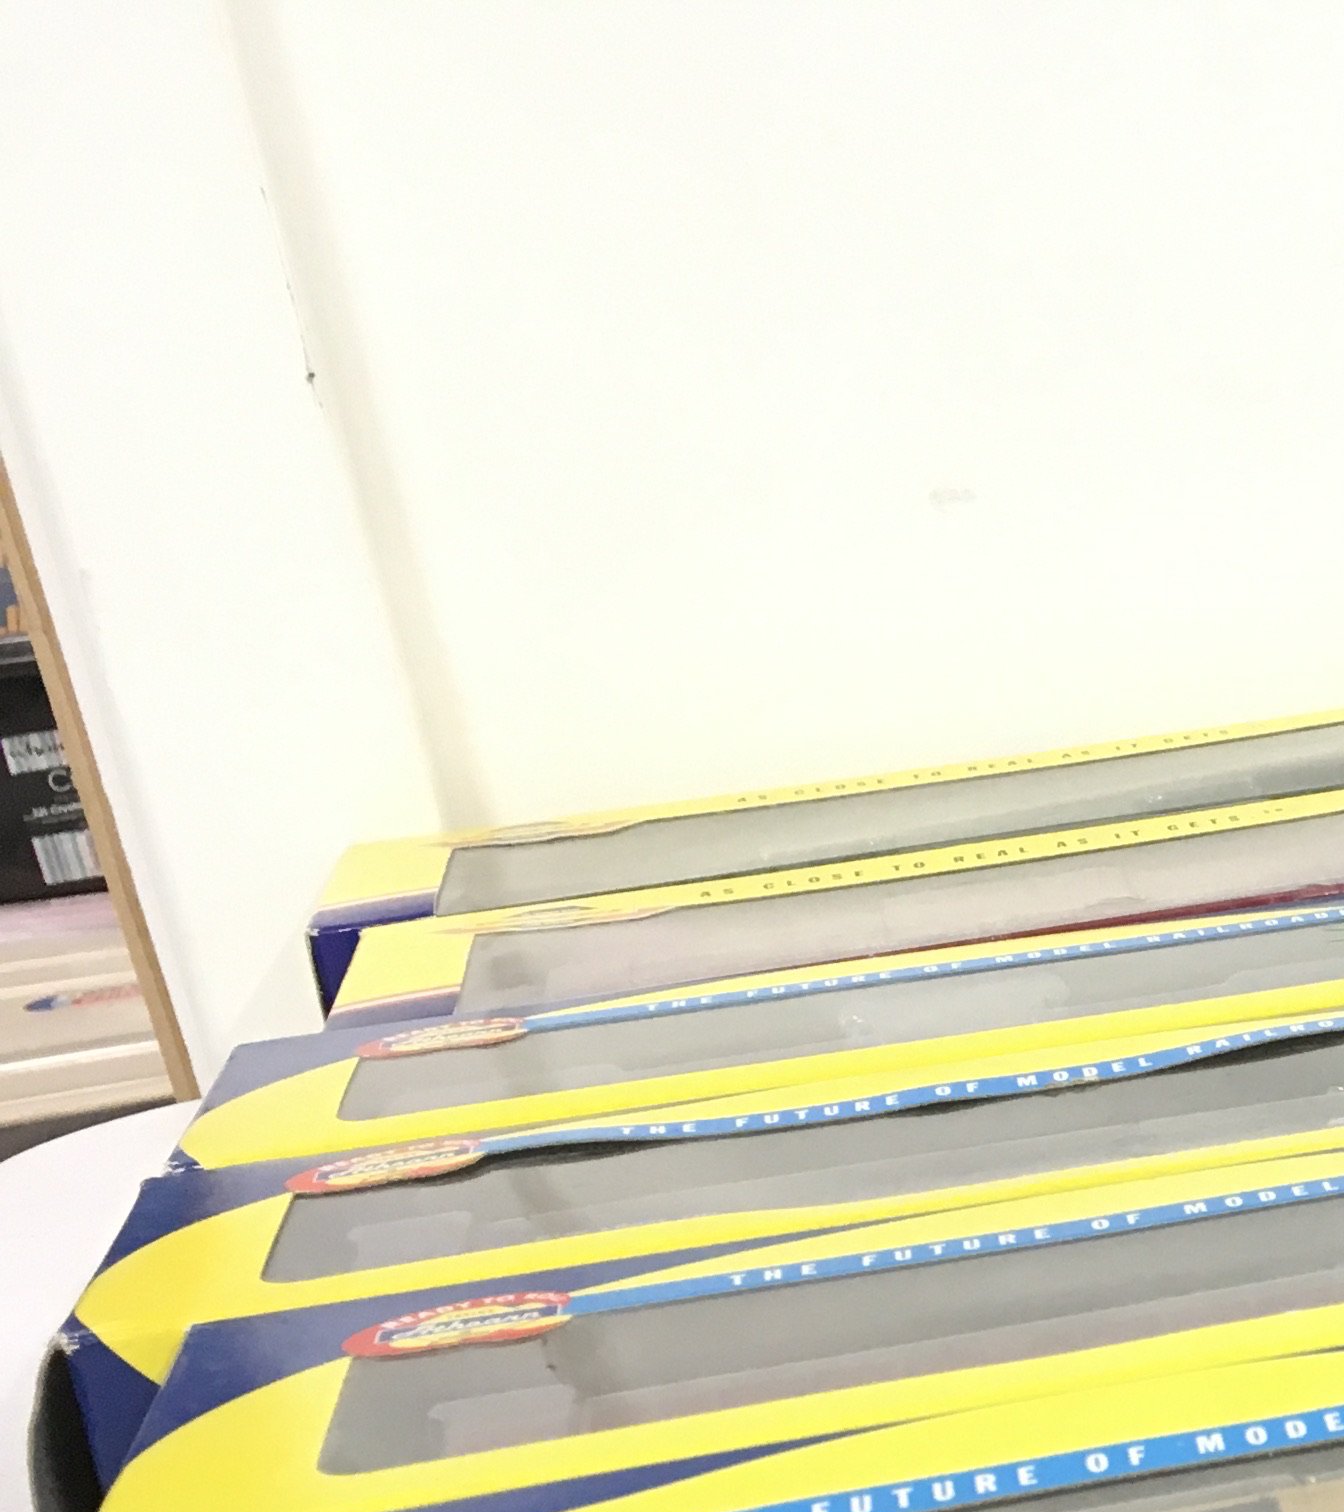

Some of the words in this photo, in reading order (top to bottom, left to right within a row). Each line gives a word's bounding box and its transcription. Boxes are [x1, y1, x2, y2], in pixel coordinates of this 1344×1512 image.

[761, 869, 868, 890] CLOSE
[892, 861, 927, 872] TO
[646, 996, 713, 1012] THE
[746, 971, 893, 998] FUTURE
[923, 961, 963, 974] OF
[995, 941, 1115, 965] MODEL
[618, 1122, 699, 1136] THE
[734, 1092, 901, 1129] FUTURE
[934, 1081, 981, 1097] OF
[1015, 1057, 1154, 1087] MODEL
[729, 1262, 820, 1288] THE
[860, 1226, 1053, 1268] FUTURE
[1088, 1212, 1143, 1232] OF
[1183, 1179, 1341, 1216] MODEL
[1084, 1444, 1148, 1474] OF
